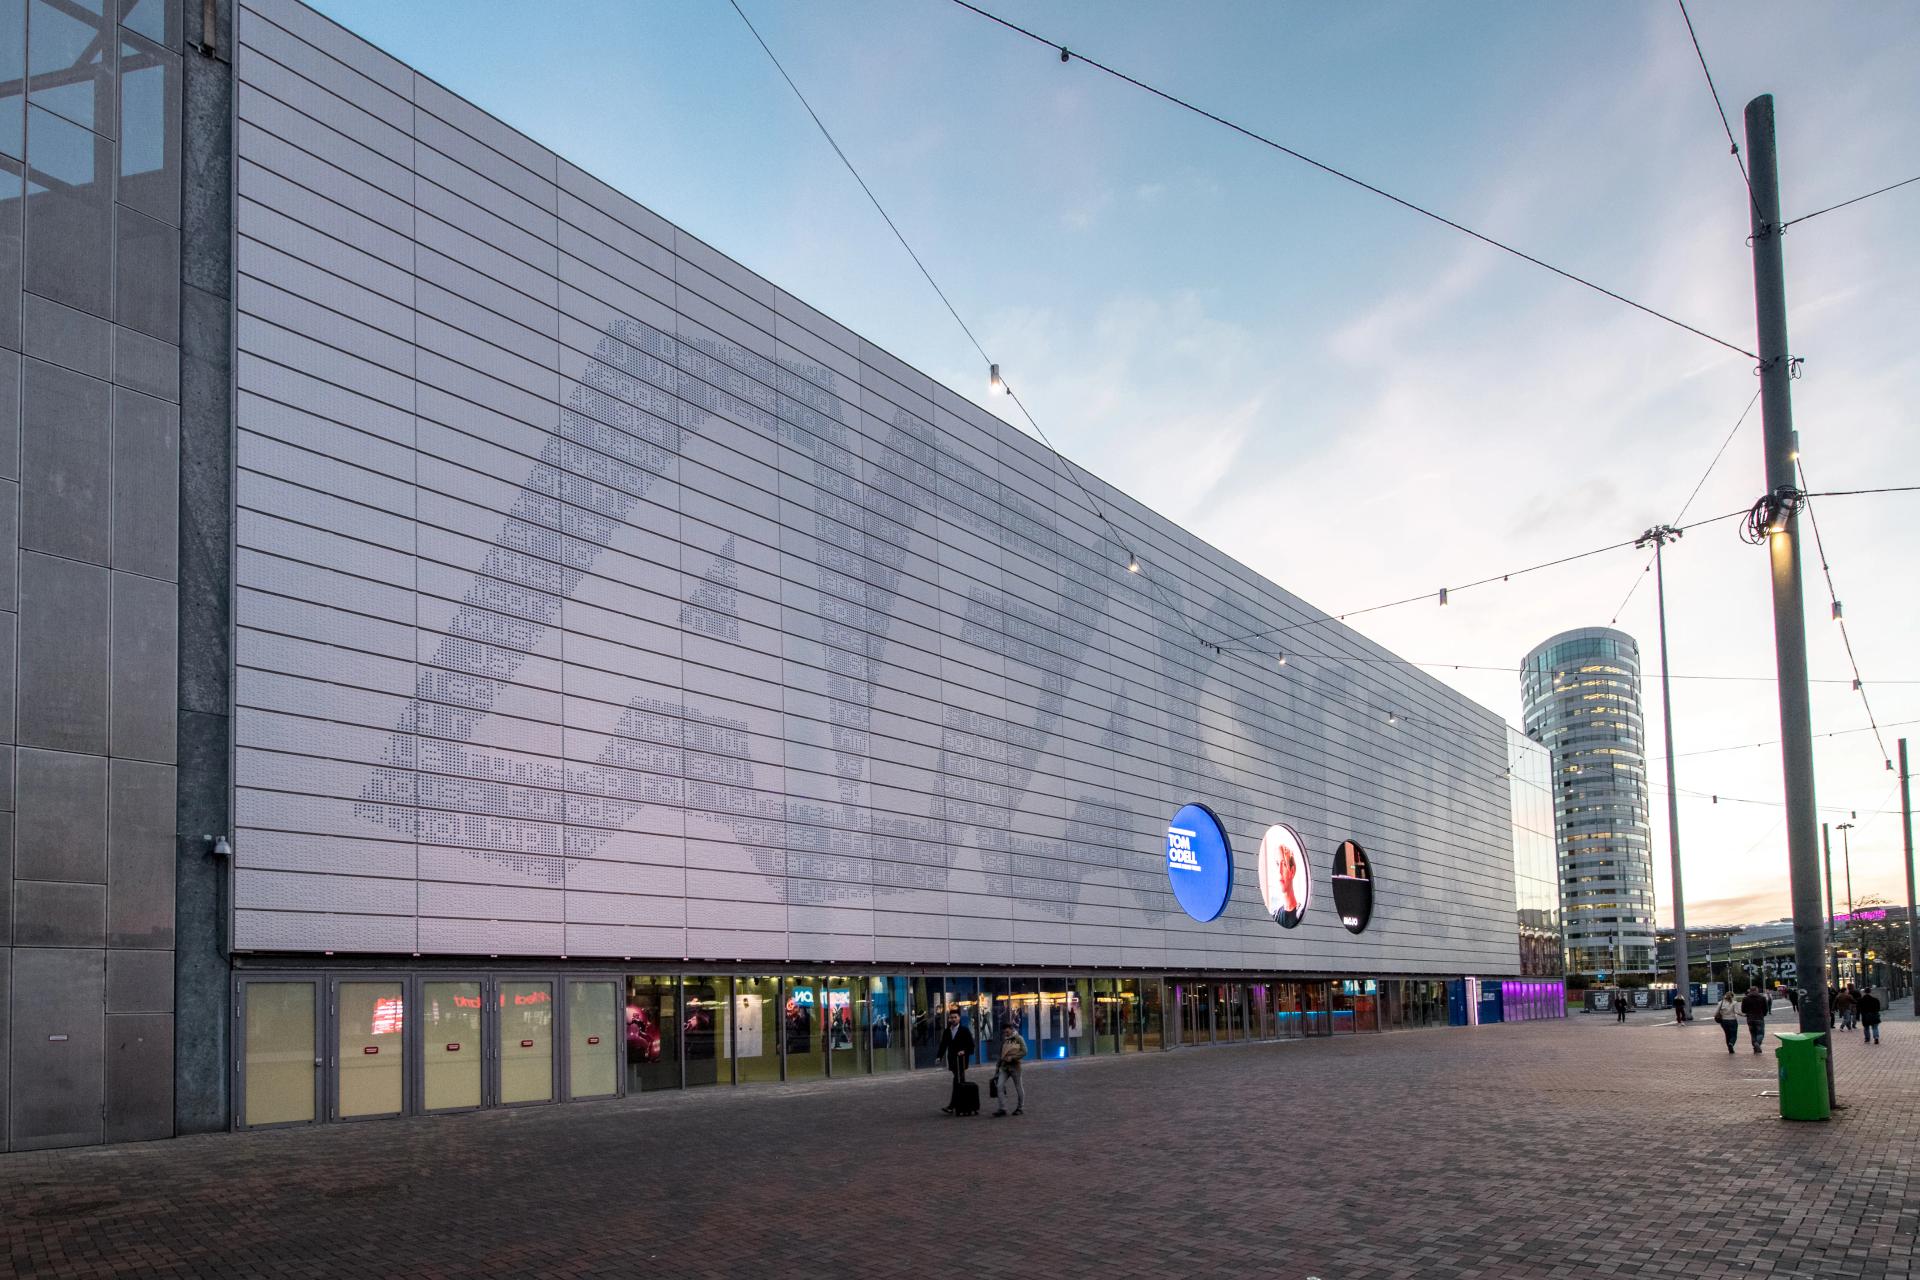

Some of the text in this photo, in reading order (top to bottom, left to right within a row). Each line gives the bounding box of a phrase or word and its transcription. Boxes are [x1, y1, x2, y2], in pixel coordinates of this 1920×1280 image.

[645, 353, 689, 395] VIP
[658, 332, 718, 381] Dark
[727, 367, 816, 430] electro
[613, 399, 663, 443] Ska
[690, 749, 747, 782] soul
[946, 752, 982, 777] Folk
[639, 771, 699, 804] Folk
[830, 828, 896, 857] P-Funk
[1168, 834, 1190, 850] TOM
[1169, 848, 1197, 864] ODELL
[771, 849, 851, 881] Garage
